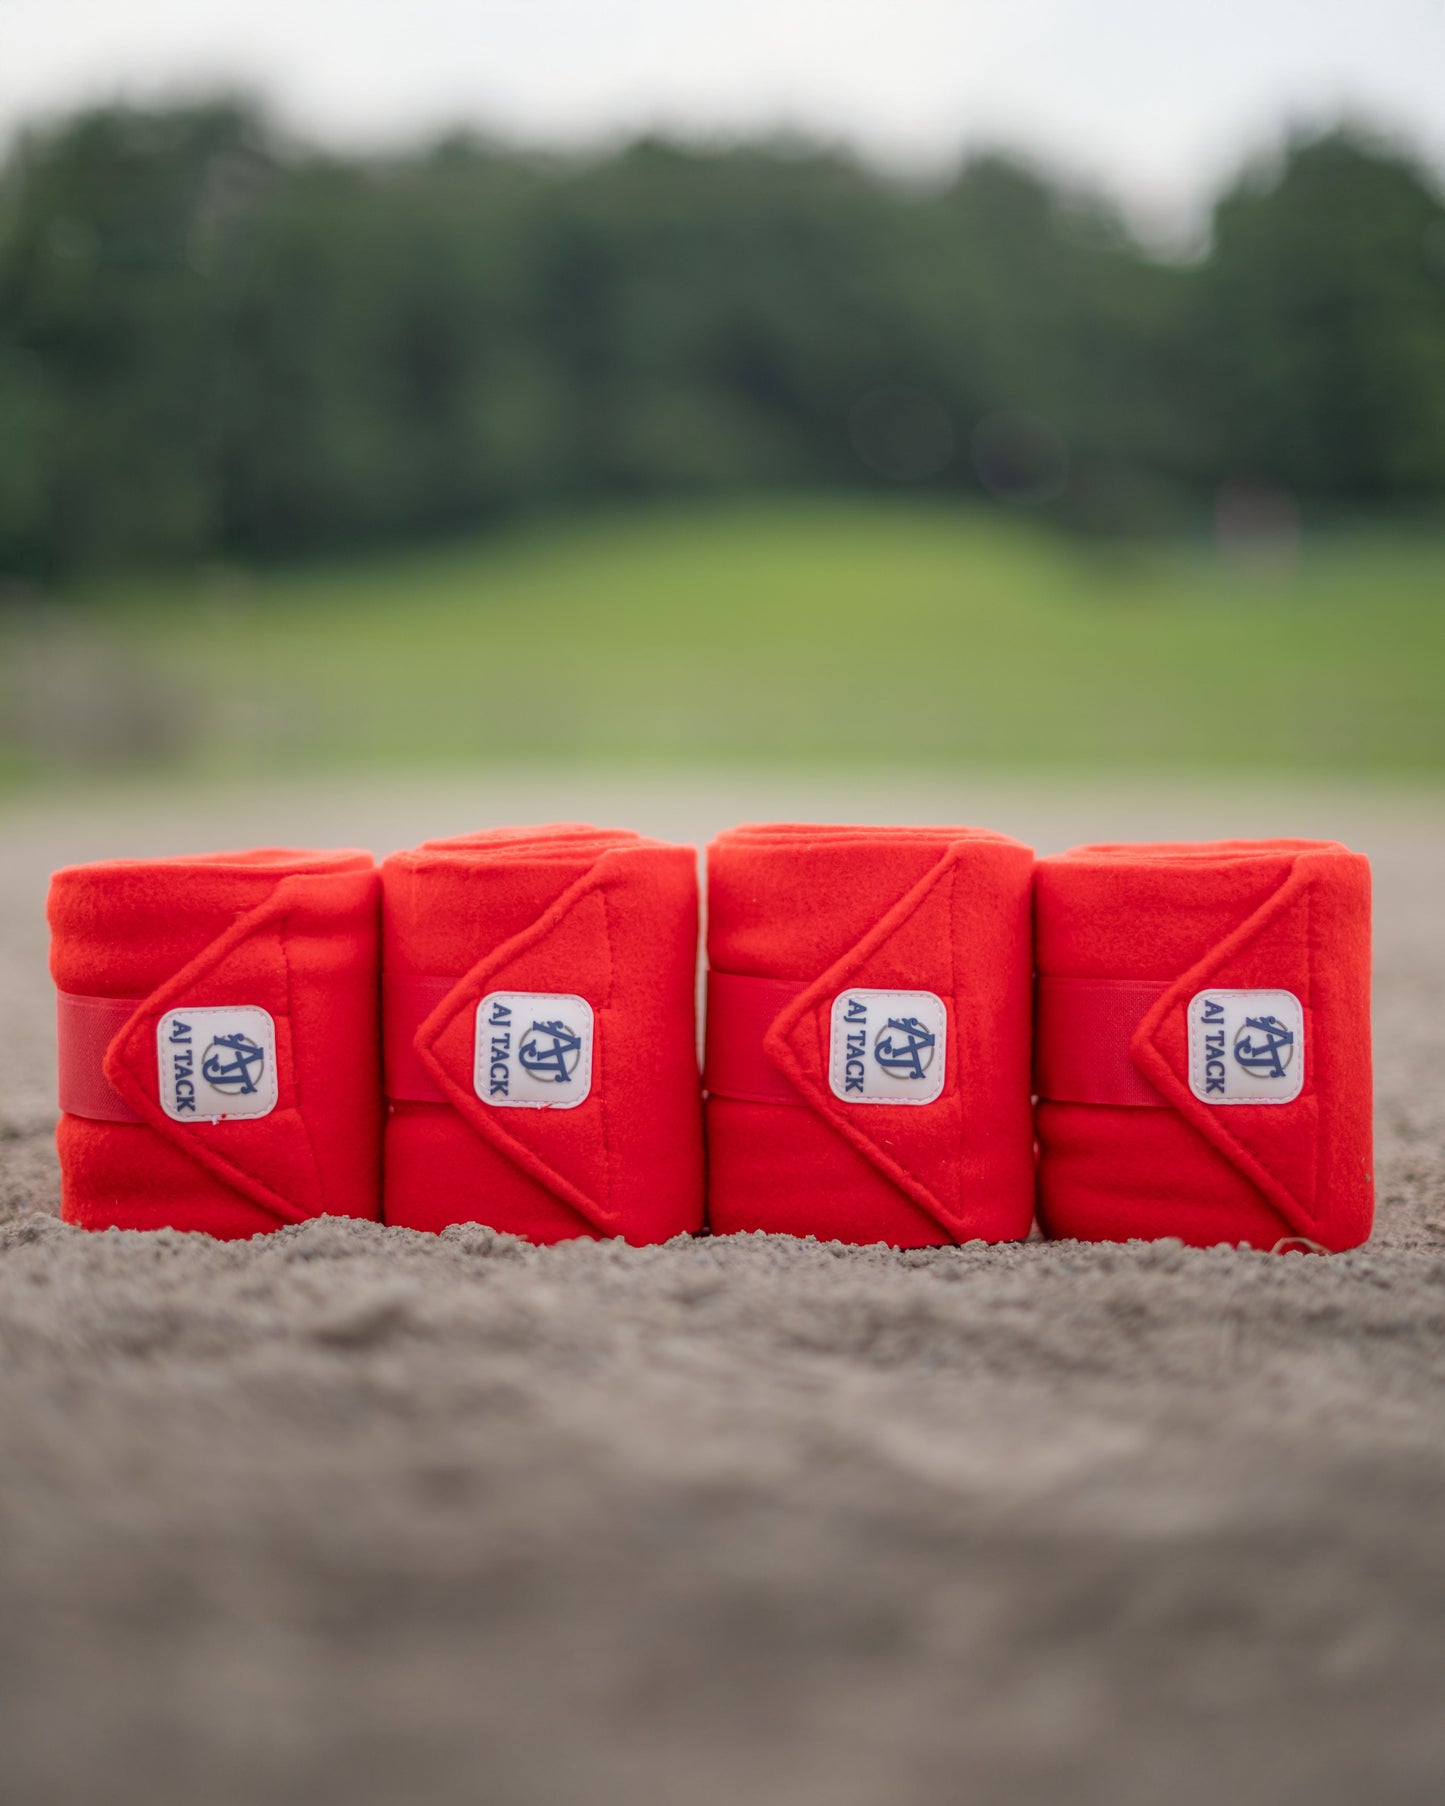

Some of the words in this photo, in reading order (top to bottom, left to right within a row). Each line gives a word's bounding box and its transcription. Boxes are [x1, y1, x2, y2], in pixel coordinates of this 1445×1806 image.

[169, 1020, 192, 1044] AJ
[488, 1002, 512, 1027] AJ
[843, 999, 868, 1024] AJ
[1201, 1000, 1224, 1025] AJ
[174, 1050, 196, 1112] TACK
[489, 1033, 512, 1096] TACK
[844, 1030, 867, 1093] TACK
[1205, 1031, 1225, 1094] TACK
